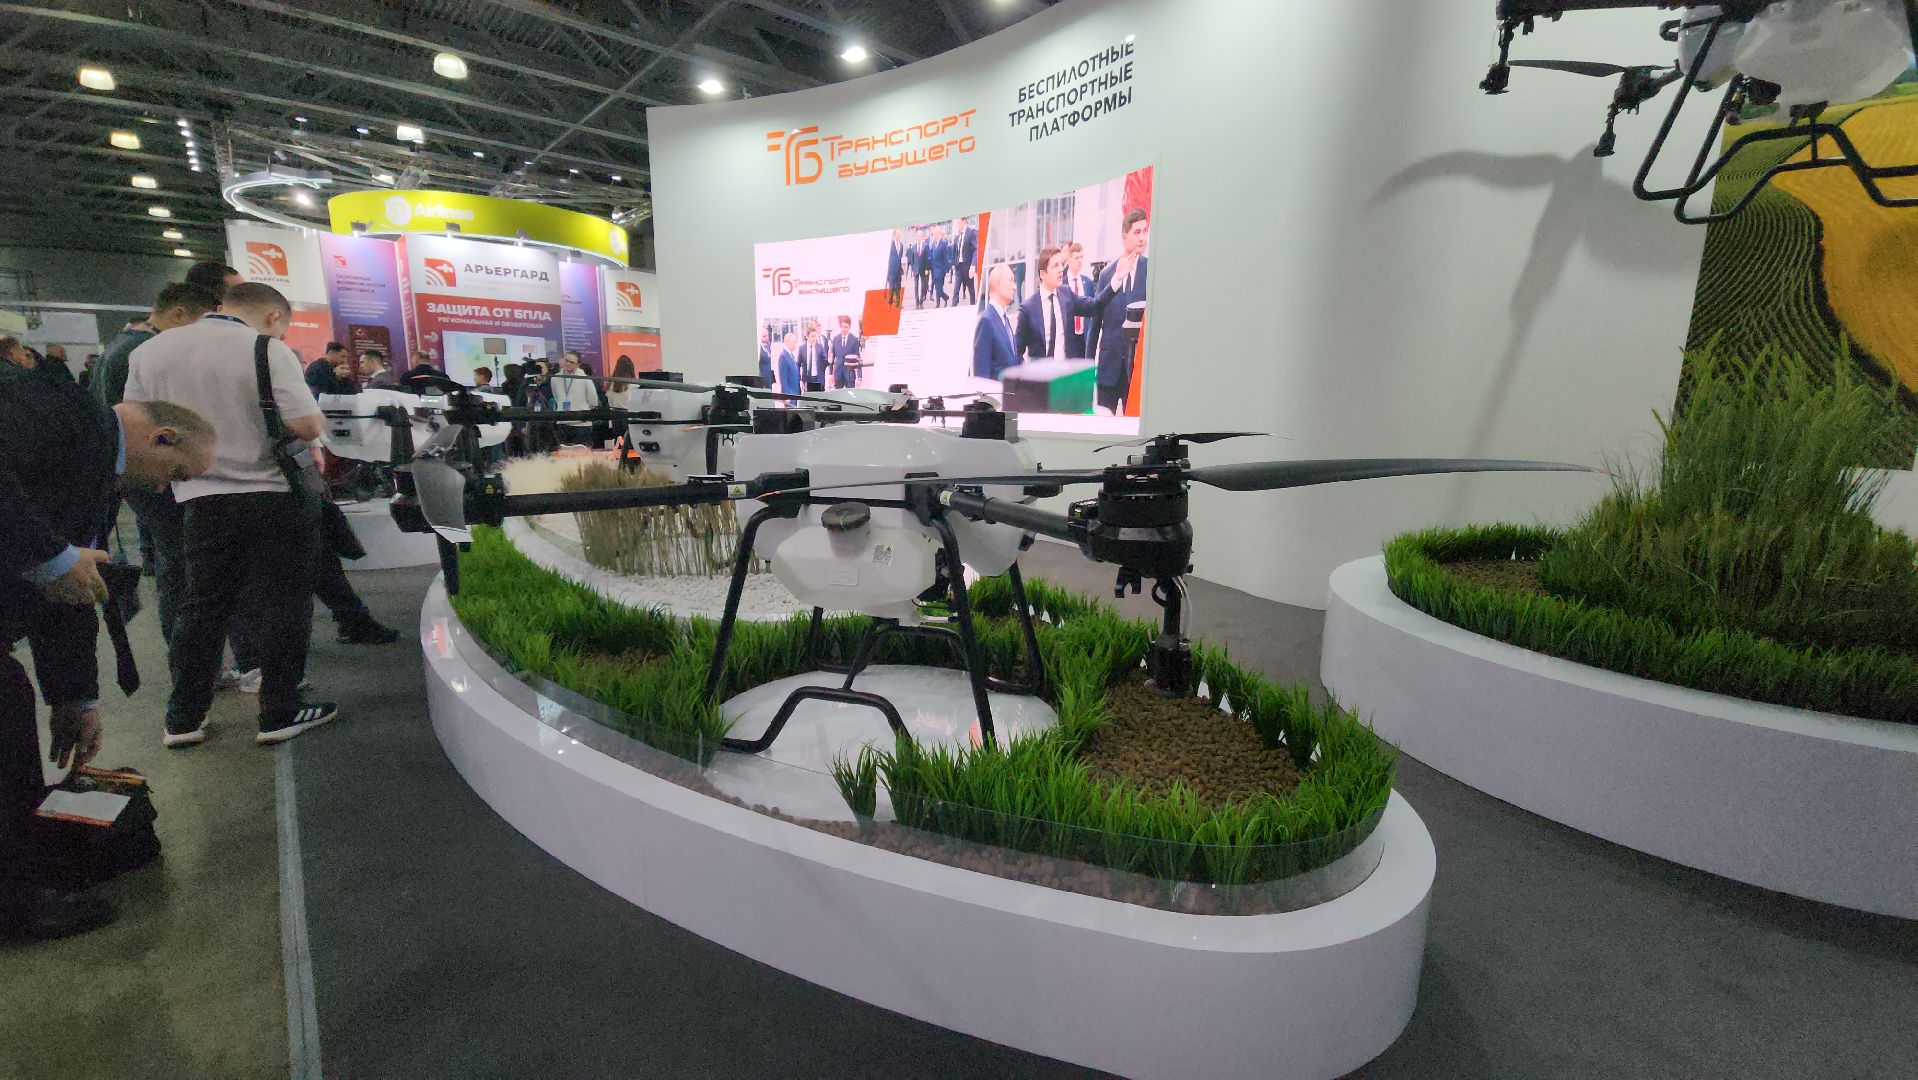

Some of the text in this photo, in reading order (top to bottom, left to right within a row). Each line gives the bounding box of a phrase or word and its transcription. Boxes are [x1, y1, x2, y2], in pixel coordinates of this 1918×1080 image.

[1018, 42, 1134, 103] БЕСПИЛОТНЫЕ
[1008, 61, 1134, 127] ТРАНСПОРТНЫЕ
[1029, 86, 1133, 142] ПЛАТФОРМЫ
[415, 202, 475, 221] Airlines
[463, 262, 550, 282] АРЬЕРГАРД
[426, 302, 493, 318] ЗАЩИТА
[492, 307, 512, 318] ОТ
[514, 309, 552, 322] БПЛА
[437, 316, 493, 327] РЕГИОНАЛЬНАЯ
